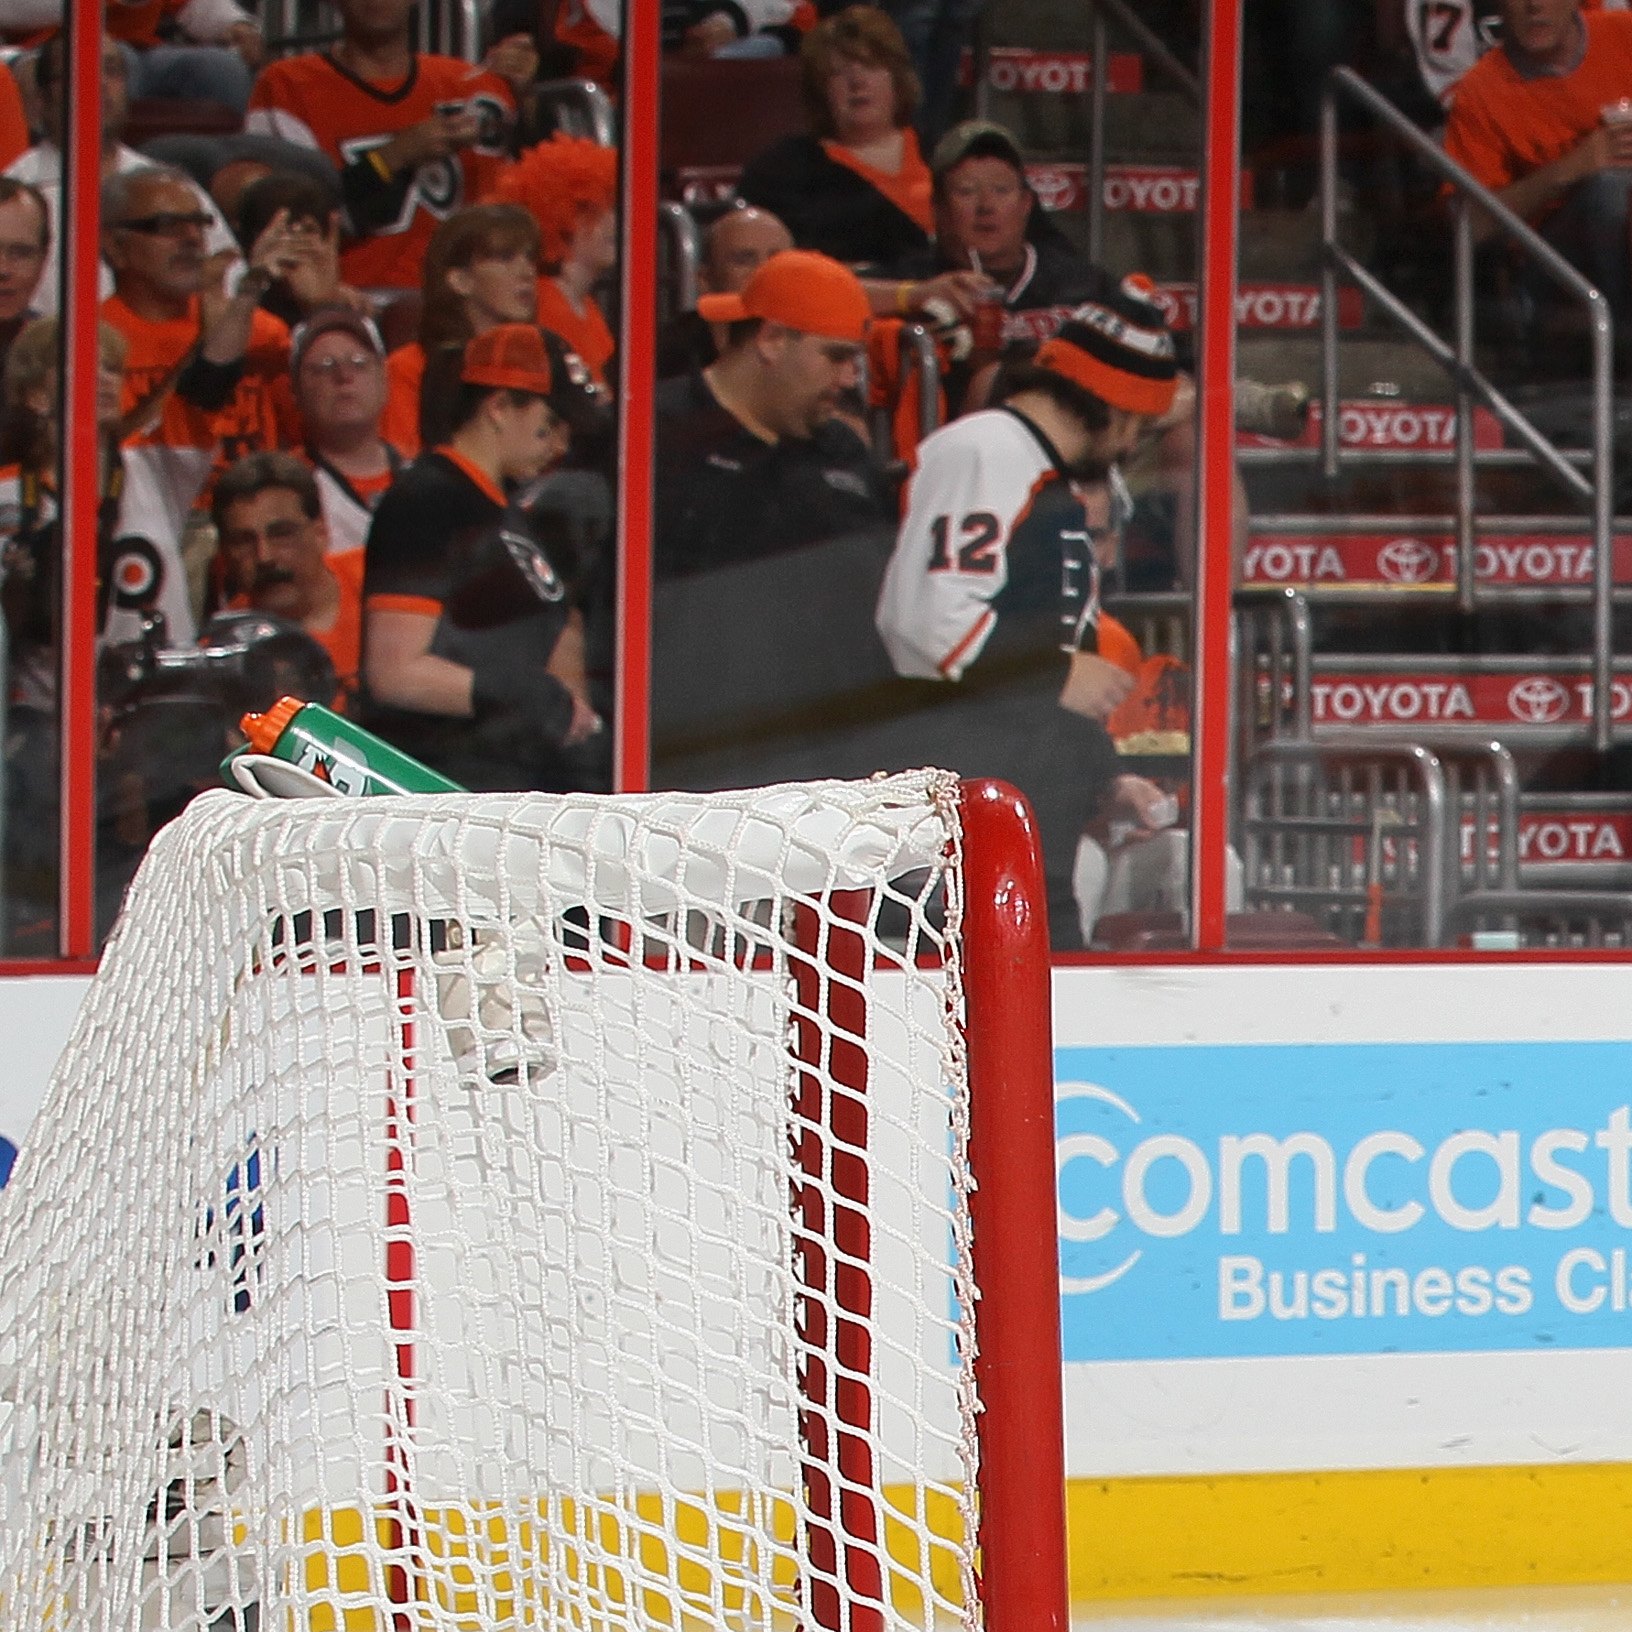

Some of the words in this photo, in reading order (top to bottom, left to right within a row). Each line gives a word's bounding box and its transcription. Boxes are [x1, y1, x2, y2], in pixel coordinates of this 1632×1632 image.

[927, 511, 1000, 576] 12
[1311, 683, 1476, 719] TOYOTA
[1219, 1254, 1534, 1320] Business
